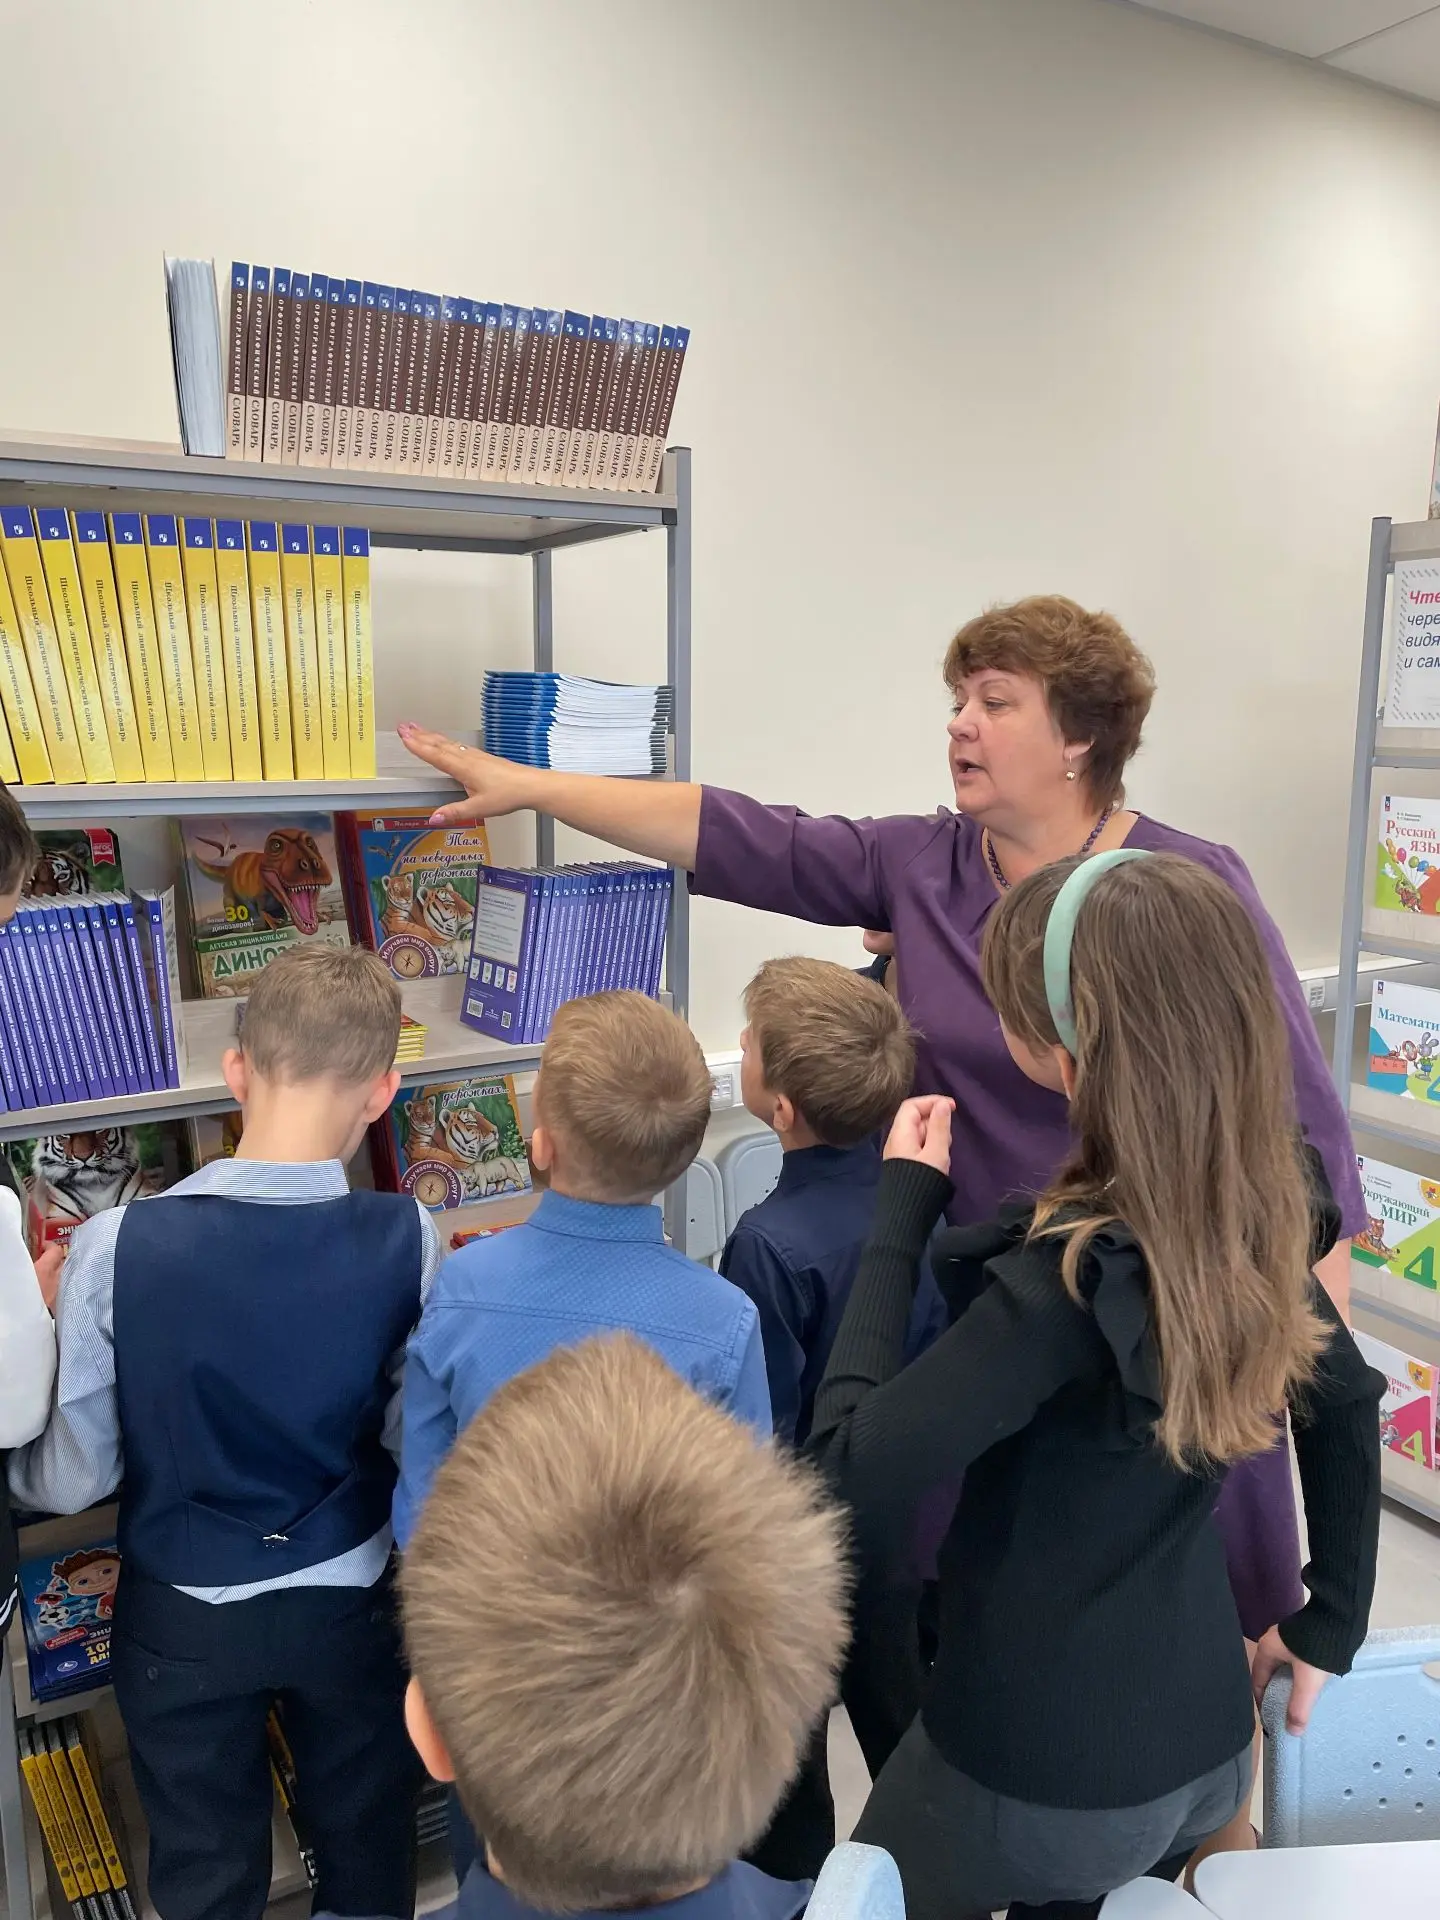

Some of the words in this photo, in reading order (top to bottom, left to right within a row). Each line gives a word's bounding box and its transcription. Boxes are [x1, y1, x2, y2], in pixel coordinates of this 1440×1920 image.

[234, 294, 242, 392] ОРФОГРАФИЧЕСКИЙ
[253, 297, 262, 394] ОРФОГРАФИЧЕСКИЙ
[274, 300, 284, 396] ОРФОГРАФИЧЕСКИЙ
[292, 304, 301, 399] ОРФОГРАФИЧЕСКИЙ
[309, 304, 320, 399] ОРФОГРАФИЧЕСКИЙ
[325, 309, 336, 403] ОРФОГРАФИЧЕСКИЙ
[342, 310, 354, 403] ОРФОГРАФИЧЕСКИЙ
[360, 312, 371, 405] ОРФОГРАФИЧЕСКИЙ
[374, 315, 387, 407] ОРФОГРАФИЧЕСКИЙ
[390, 317, 403, 409] ОРФОГРАФИЧЕСКИЙ
[405, 320, 418, 411] ОРФОГРАФИЧЕСКИЙ
[418, 323, 432, 412] ОРФОГРАФИЧЕСКИЙ
[434, 325, 449, 414] ОРФОГРАФИЧЕСКИЙ
[451, 327, 465, 416] ОРФОГРАФИЧЕСКИЙ
[464, 329, 479, 417] ОРФОГРАФИЧЕСКИЙ
[494, 332, 509, 420] ОРФОГРАФИЧЕСКИЙ
[507, 335, 523, 421] ОРФОГРАФИЧЕСКИЙ
[521, 336, 538, 424] ОРФОГРАФИЧЕСКИЙ
[551, 338, 569, 425] ОРФОГРАФИЧЕСКИЙ
[563, 342, 580, 427] ОРФОГРАФИЧЕСКИЙ
[578, 343, 597, 427] ОРФОГРАФИЧЕСКИЙ
[591, 345, 609, 429] ОРФОГРАФИЧЕСКИЙ
[631, 350, 650, 432] ОРФОГРАФИЧЕСКИЙ
[646, 351, 666, 433] ОРФОГРАФИЧЕСКИЙ
[659, 352, 679, 434] ОРФОГРАФИЧЕСКИЙ
[232, 398, 240, 446] СЛОВАРЬ
[251, 400, 259, 448] СЛОВАРЬ
[270, 402, 280, 449] СЛОВАРЬ
[288, 405, 297, 452] СЛОВАРЬ
[305, 405, 315, 452] СЛОВАРЬ
[320, 408, 330, 454] СЛОВАРЬ
[338, 409, 348, 455] СЛОВАРЬ
[354, 411, 364, 456] СЛОВАРЬ
[369, 413, 379, 458] СЛОВАРЬ
[385, 415, 395, 460] СЛОВАРЬ
[400, 416, 410, 461] СЛОВАРЬ
[413, 418, 423, 463] СЛОВАРЬ
[428, 419, 439, 464] СЛОВАРЬ
[444, 421, 455, 465] СЛОВАРЬ
[457, 423, 468, 466] СЛОВАРЬ
[471, 424, 481, 468] СЛОВАРЬ
[487, 425, 498, 469] СЛОВАРЬ
[500, 427, 511, 470] СЛОВАРЬ
[514, 428, 525, 471] СЛОВАРЬ
[528, 429, 539, 472] СЛОВАРЬ
[543, 429, 555, 471] СЛОВАРЬ
[555, 432, 566, 474] СЛОВАРЬ
[569, 432, 581, 475] СЛОВАРЬ
[582, 433, 594, 475] СЛОВАРЬ
[597, 434, 609, 476] СЛОВАРЬ
[611, 436, 623, 477] СЛОВАРЬ
[621, 437, 634, 478] СЛОВАРЬ
[636, 438, 649, 478] СЛОВАРЬ
[649, 438, 661, 479] СЛОВАРЬ
[1404, 658, 1413, 668] и
[1405, 633, 1440, 648] видя
[1386, 820, 1436, 839] Русский
[422, 850, 484, 867] неведомых
[225, 905, 248, 921] 30
[209, 941, 238, 951] ДЕТСКАЯ
[1380, 1204, 1417, 1226] МИР
[1404, 1246, 1437, 1289] 4
[1402, 1430, 1427, 1466] 4
